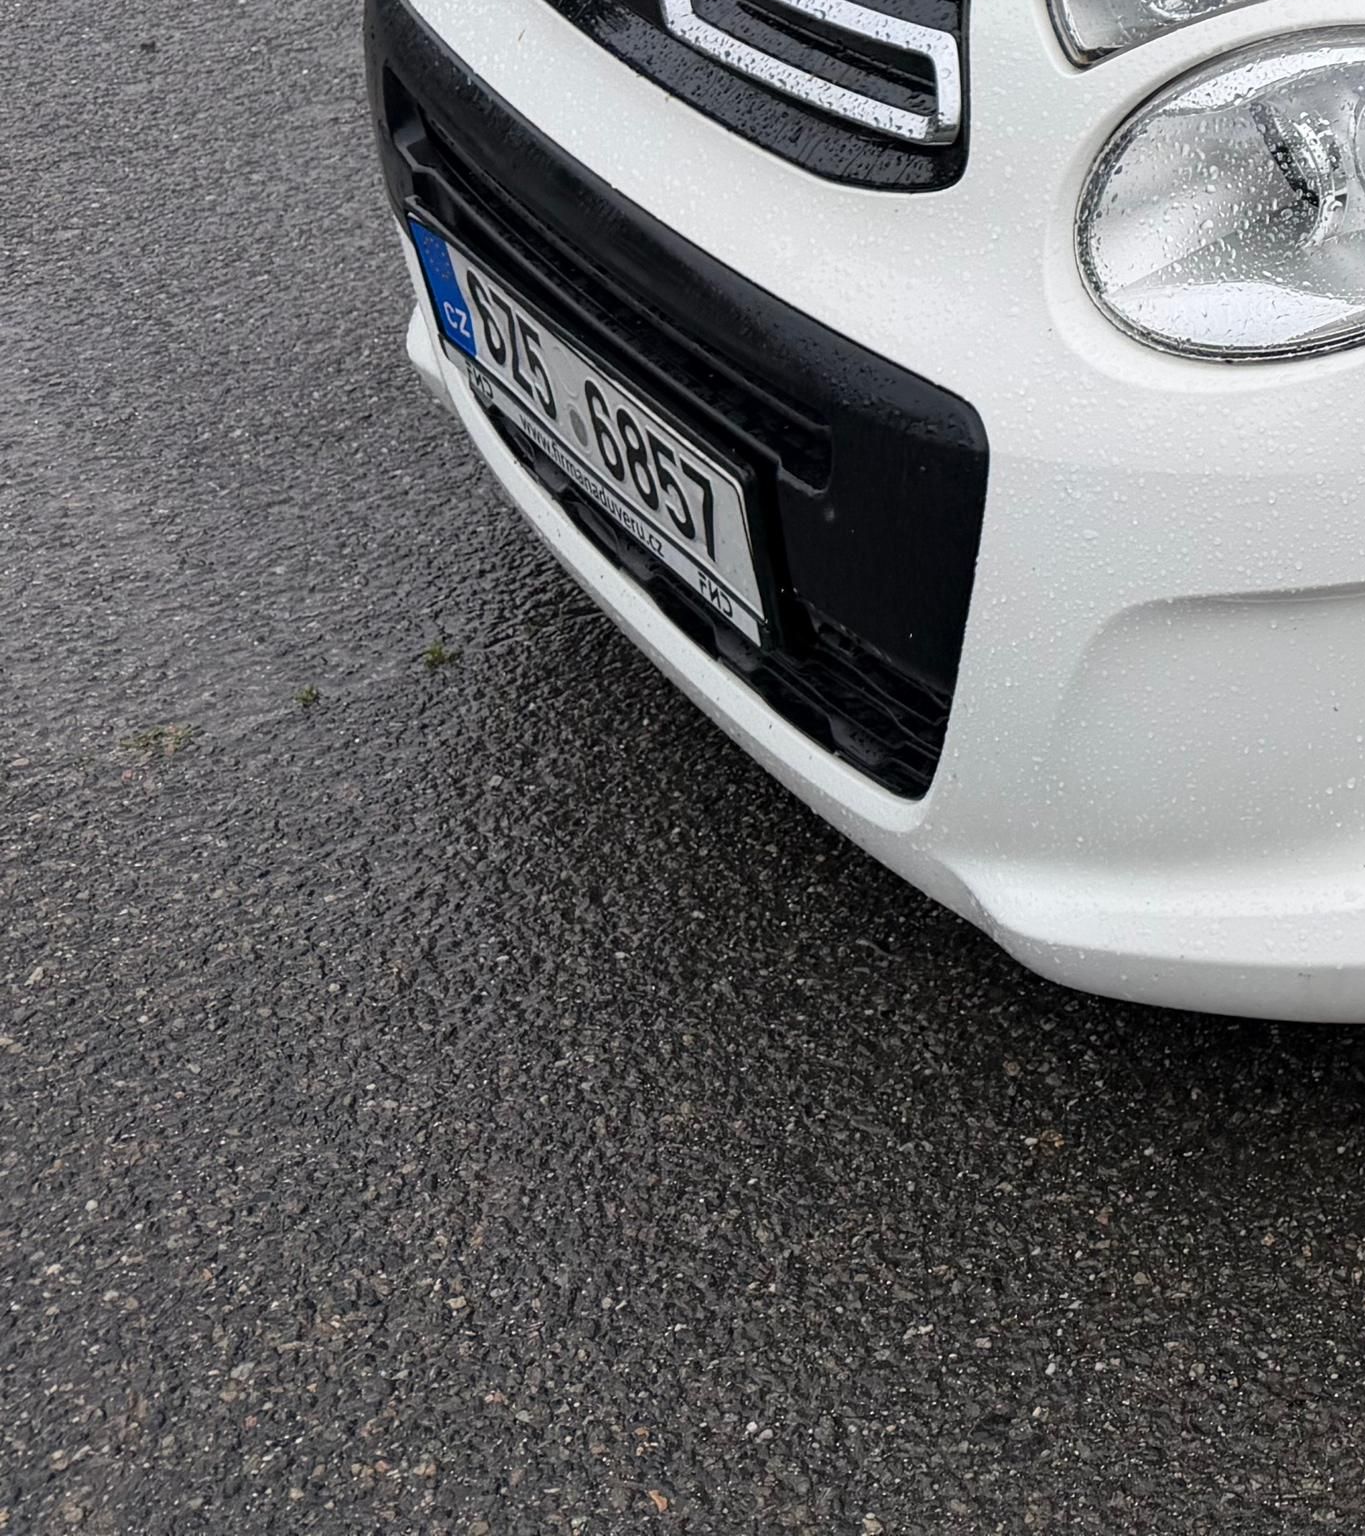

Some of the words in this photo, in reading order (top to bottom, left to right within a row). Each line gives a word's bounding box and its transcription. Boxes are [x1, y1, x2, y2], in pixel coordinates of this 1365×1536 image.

[443, 300, 471, 338] CZ
[466, 269, 557, 421] 6Z5
[585, 379, 716, 562] 6857
